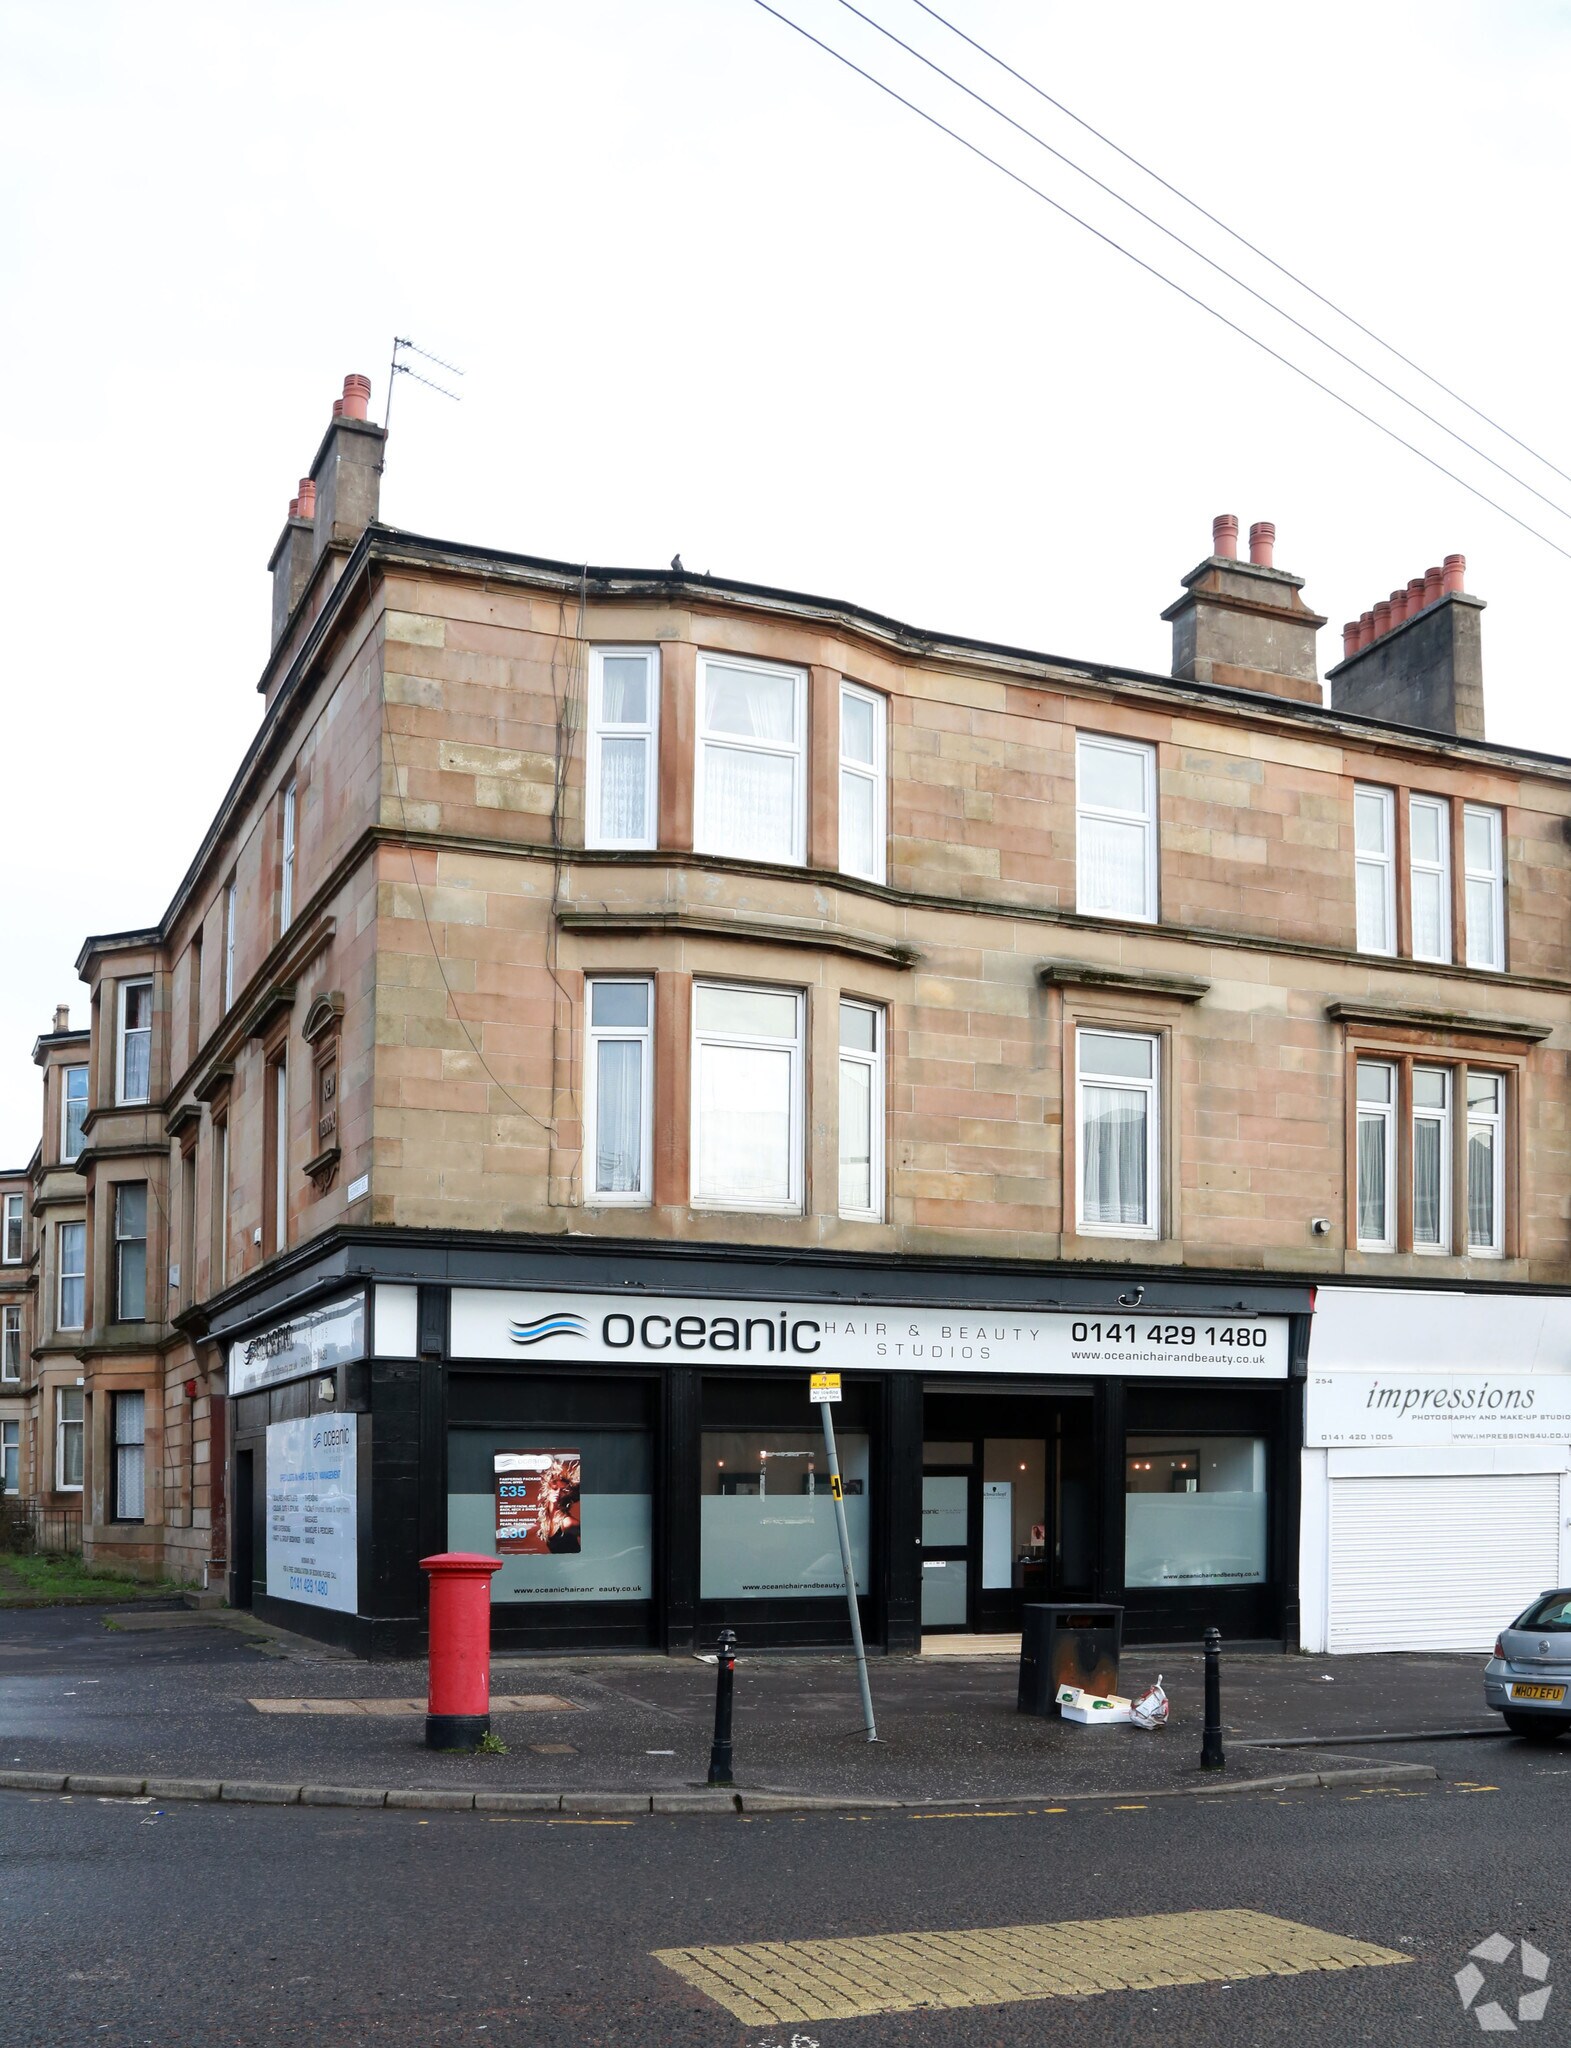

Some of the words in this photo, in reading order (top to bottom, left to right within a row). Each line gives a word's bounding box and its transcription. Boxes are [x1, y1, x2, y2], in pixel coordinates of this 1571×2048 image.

[602, 1311, 821, 1353] oceanic
[824, 1322, 887, 1335] HAIR
[908, 1324, 920, 1336] &
[941, 1326, 1040, 1341] BEAUTY
[1072, 1322, 1135, 1343] 0141
[1147, 1325, 1195, 1345] 429
[1205, 1327, 1267, 1347] 1480
[877, 1343, 990, 1360] STUDIOS
[1071, 1351, 1265, 1365] www.oceanichairandbeauty.co.uk
[1366, 1381, 1535, 1418] impressions
[323, 1425, 350, 1447] oceanic
[500, 1486, 526, 1497] £35
[500, 1527, 527, 1539] £30
[1163, 1571, 1260, 1579] www.oceanichairandbeauty.co.uk
[290, 1576, 302, 1591] 0141
[304, 1579, 313, 1593] 429
[315, 1579, 328, 1596] 1480
[1515, 1687, 1537, 1697] MH07
[1540, 1688, 1560, 1698] EFU
